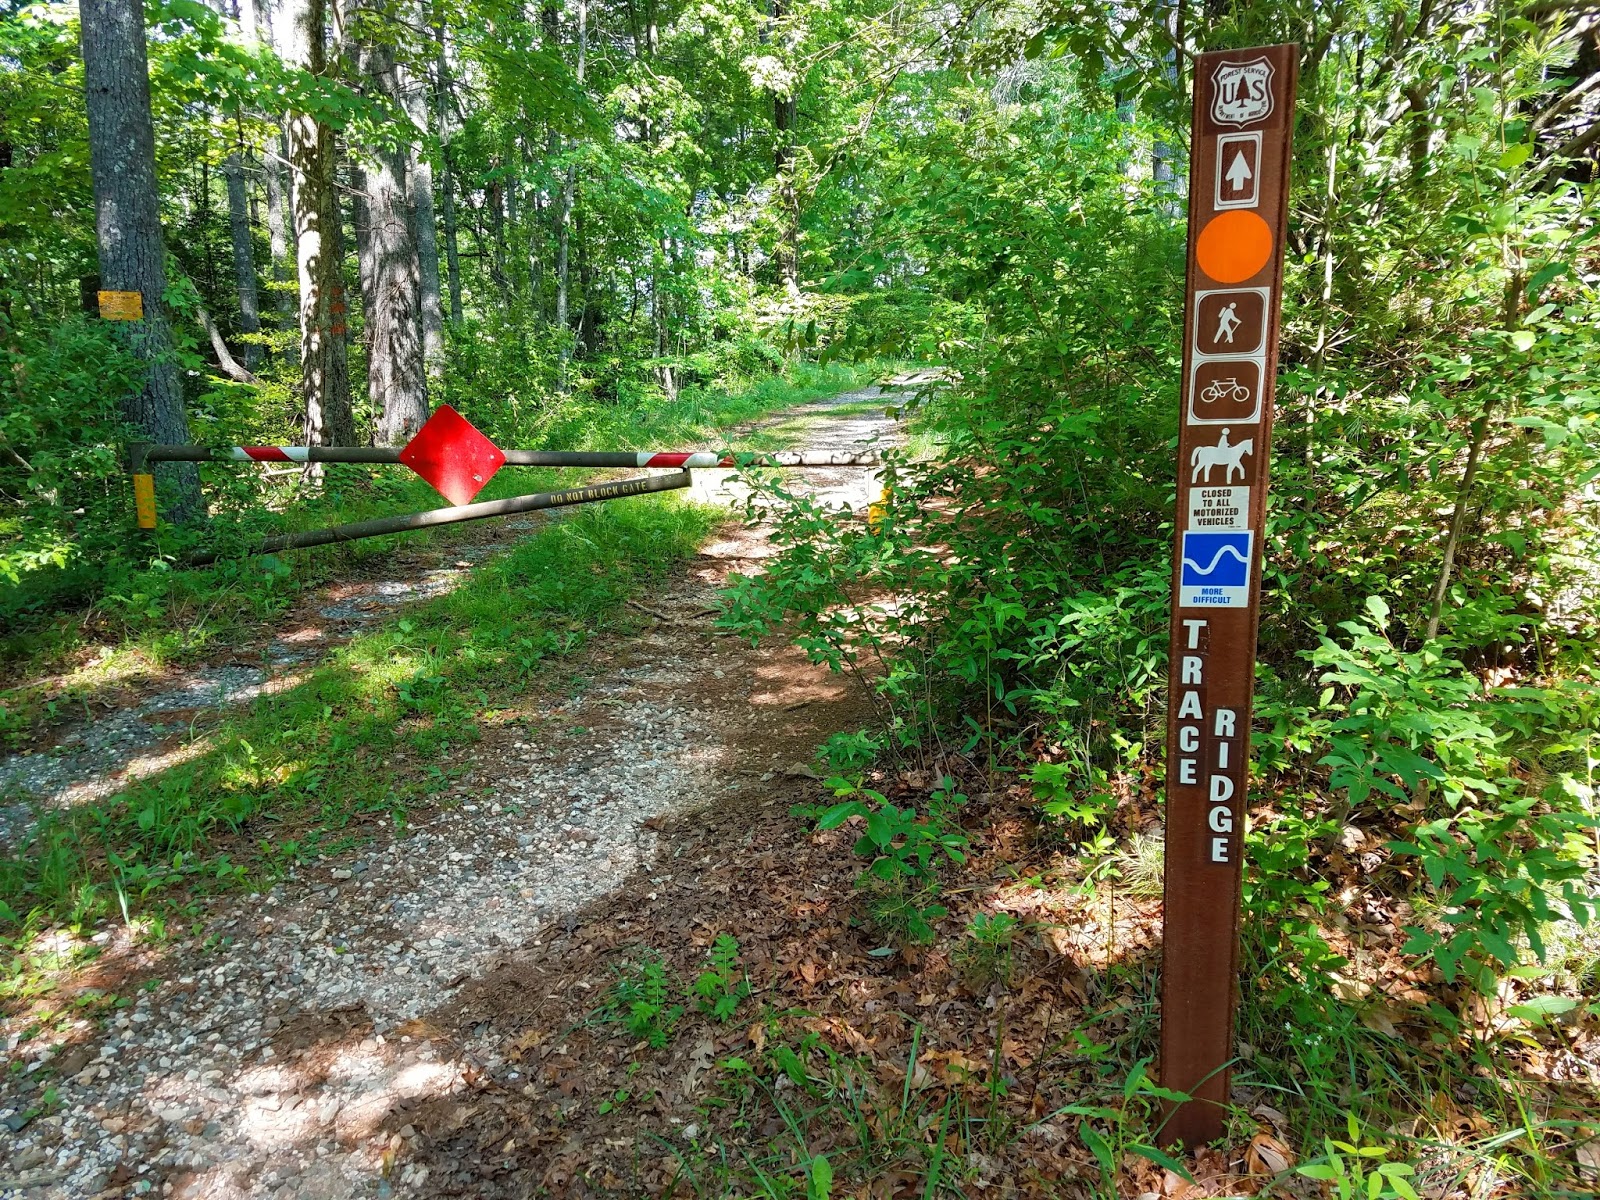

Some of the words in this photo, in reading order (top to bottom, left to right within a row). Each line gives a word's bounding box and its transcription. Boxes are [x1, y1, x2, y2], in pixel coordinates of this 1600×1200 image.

[550, 494, 563, 504] DO
[566, 490, 584, 502] NOT
[588, 485, 619, 499] BLOCK
[622, 481, 648, 494] GATE
[1201, 489, 1232, 498] CLOSED
[1202, 499, 1213, 507] TO
[1216, 499, 1230, 507] ALL
[1193, 507, 1239, 517] MOTORIZED
[1197, 517, 1234, 526] VEHICLES
[1178, 619, 1207, 785] TRACE
[1208, 709, 1236, 863] RIDGE
